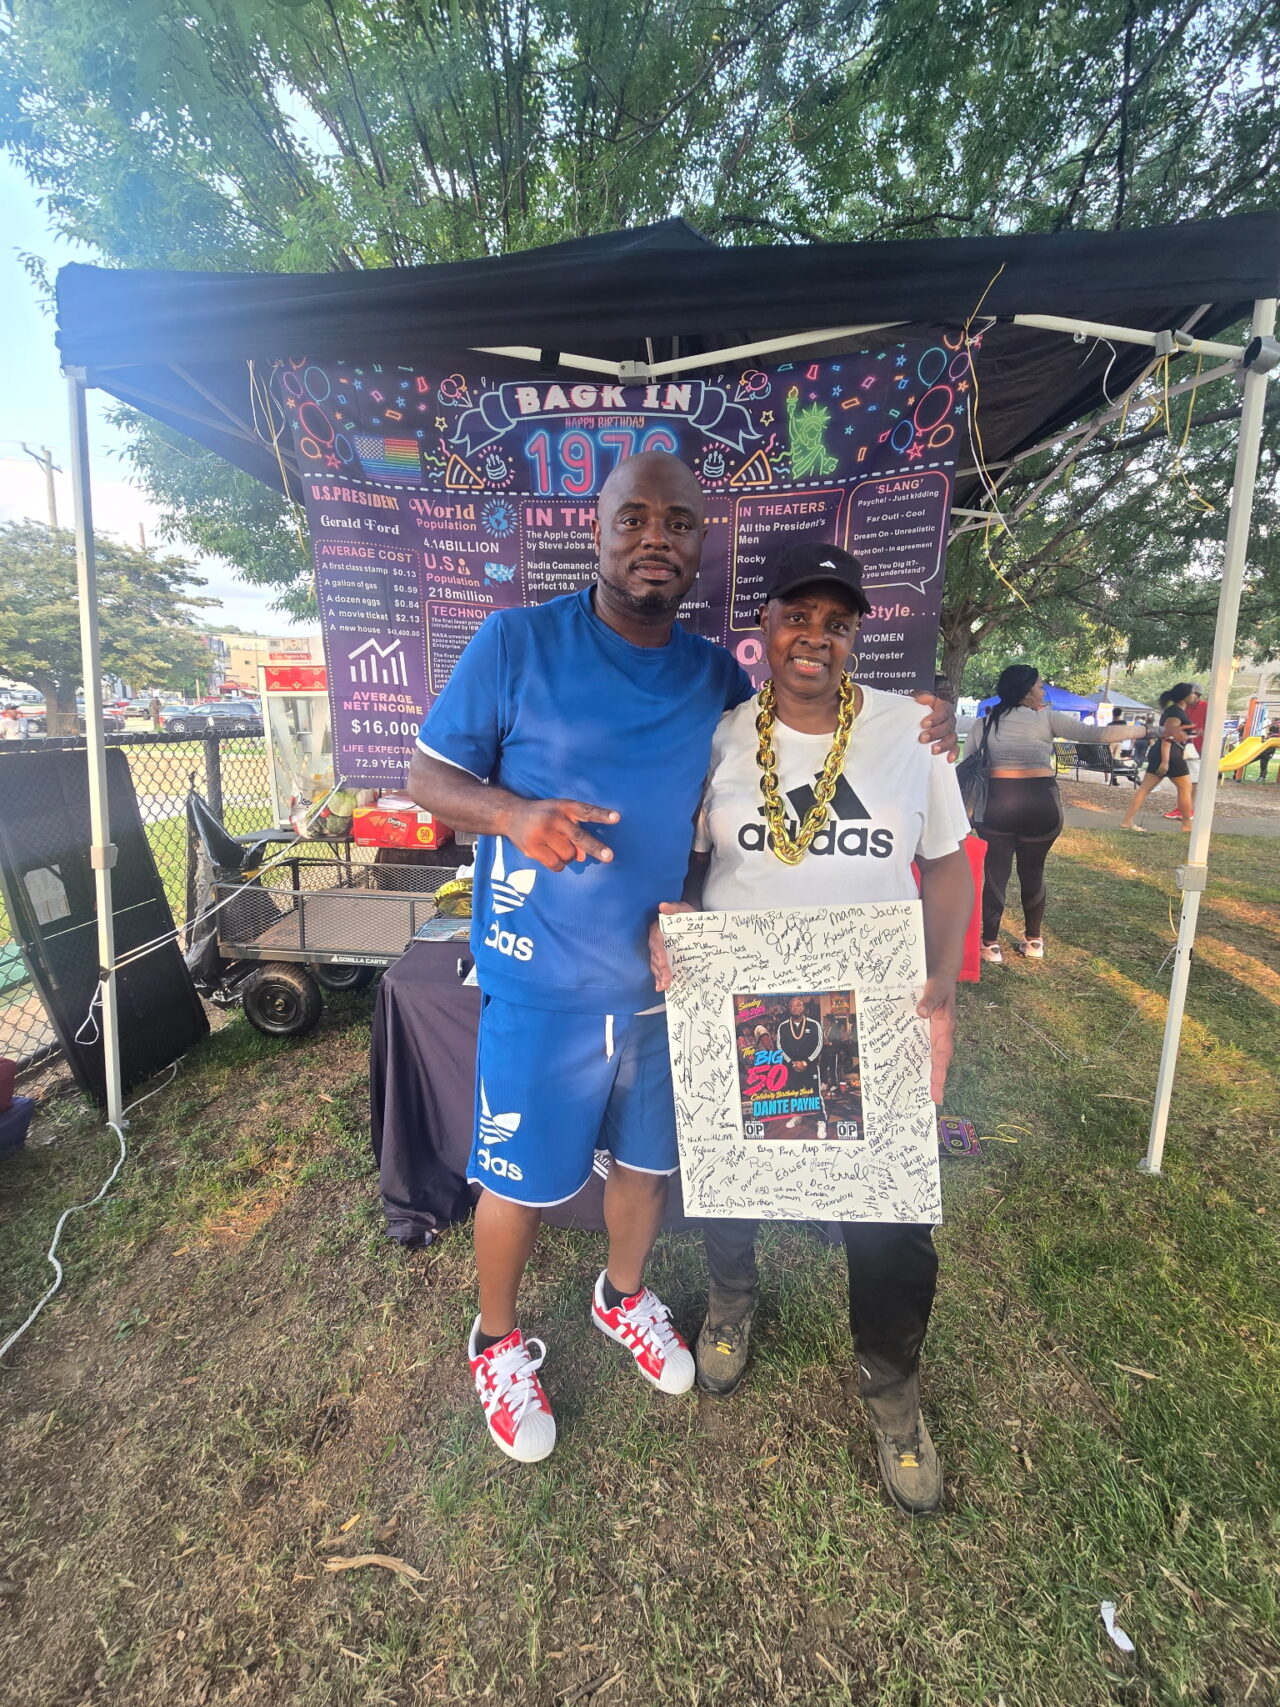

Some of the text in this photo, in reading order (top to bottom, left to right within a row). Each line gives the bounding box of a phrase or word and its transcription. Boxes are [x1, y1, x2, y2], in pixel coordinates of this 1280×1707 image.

[643, 383, 691, 412] IN
[565, 416, 645, 429] HAPPY BIRTHDAY
[892, 494, 909, 502] Just
[910, 490, 939, 500] kidding
[408, 498, 476, 520] World
[739, 507, 752, 517] IN
[526, 508, 553, 527] IN
[866, 515, 880, 523] Far
[905, 509, 926, 518] Cool
[320, 514, 400, 536] Gerald Ford
[416, 518, 477, 531] Population
[739, 518, 826, 533] All the President's
[526, 530, 542, 539] The
[543, 530, 569, 540] Apple
[853, 532, 877, 541] Dream
[894, 525, 936, 536] Unrealistic
[738, 535, 760, 544] Men
[526, 541, 586, 551] by Steve Jobs
[896, 542, 933, 551] agreement
[321, 545, 413, 563] AVERAGE COST
[737, 555, 767, 565] Rocky
[328, 562, 345, 571] first
[345, 563, 363, 572] class
[364, 565, 389, 575] stamp
[392, 567, 417, 578] $0.13
[527, 561, 551, 570] Nadia
[552, 561, 593, 570] Comaneci
[878, 562, 892, 570] You
[527, 572, 544, 580] first
[545, 572, 580, 581] gymnast
[581, 572, 590, 580] in
[880, 567, 926, 577] understand?
[426, 573, 480, 587] Population
[736, 575, 764, 584] Carrie
[332, 580, 355, 589] gallon
[356, 581, 364, 589] of
[364, 582, 378, 590] gas
[393, 584, 418, 594] $0.59
[528, 582, 557, 591] perfect
[326, 594, 420, 609] A dozen eggs $0.84
[735, 593, 751, 602] The
[328, 609, 421, 624] A movie ticket $2.13
[675, 611, 691, 619] ion
[734, 609, 752, 618] Taxi
[330, 623, 337, 631] A
[339, 624, 357, 632] new
[357, 624, 381, 634] house
[863, 632, 905, 643] WOMEN
[859, 652, 905, 661] Polyester
[876, 671, 917, 679] trousers
[353, 691, 414, 704] AVERAGE
[343, 701, 424, 715] NET INCOME
[351, 718, 419, 737] $16,000
[342, 744, 364, 753] LIFE
[355, 758, 378, 768] 72.9
[741, 1046, 757, 1058] The
[754, 1049, 786, 1067] BIG
[742, 1063, 789, 1096] 50
[753, 1099, 790, 1117] DANTE
[790, 1096, 821, 1112] PAYNE
